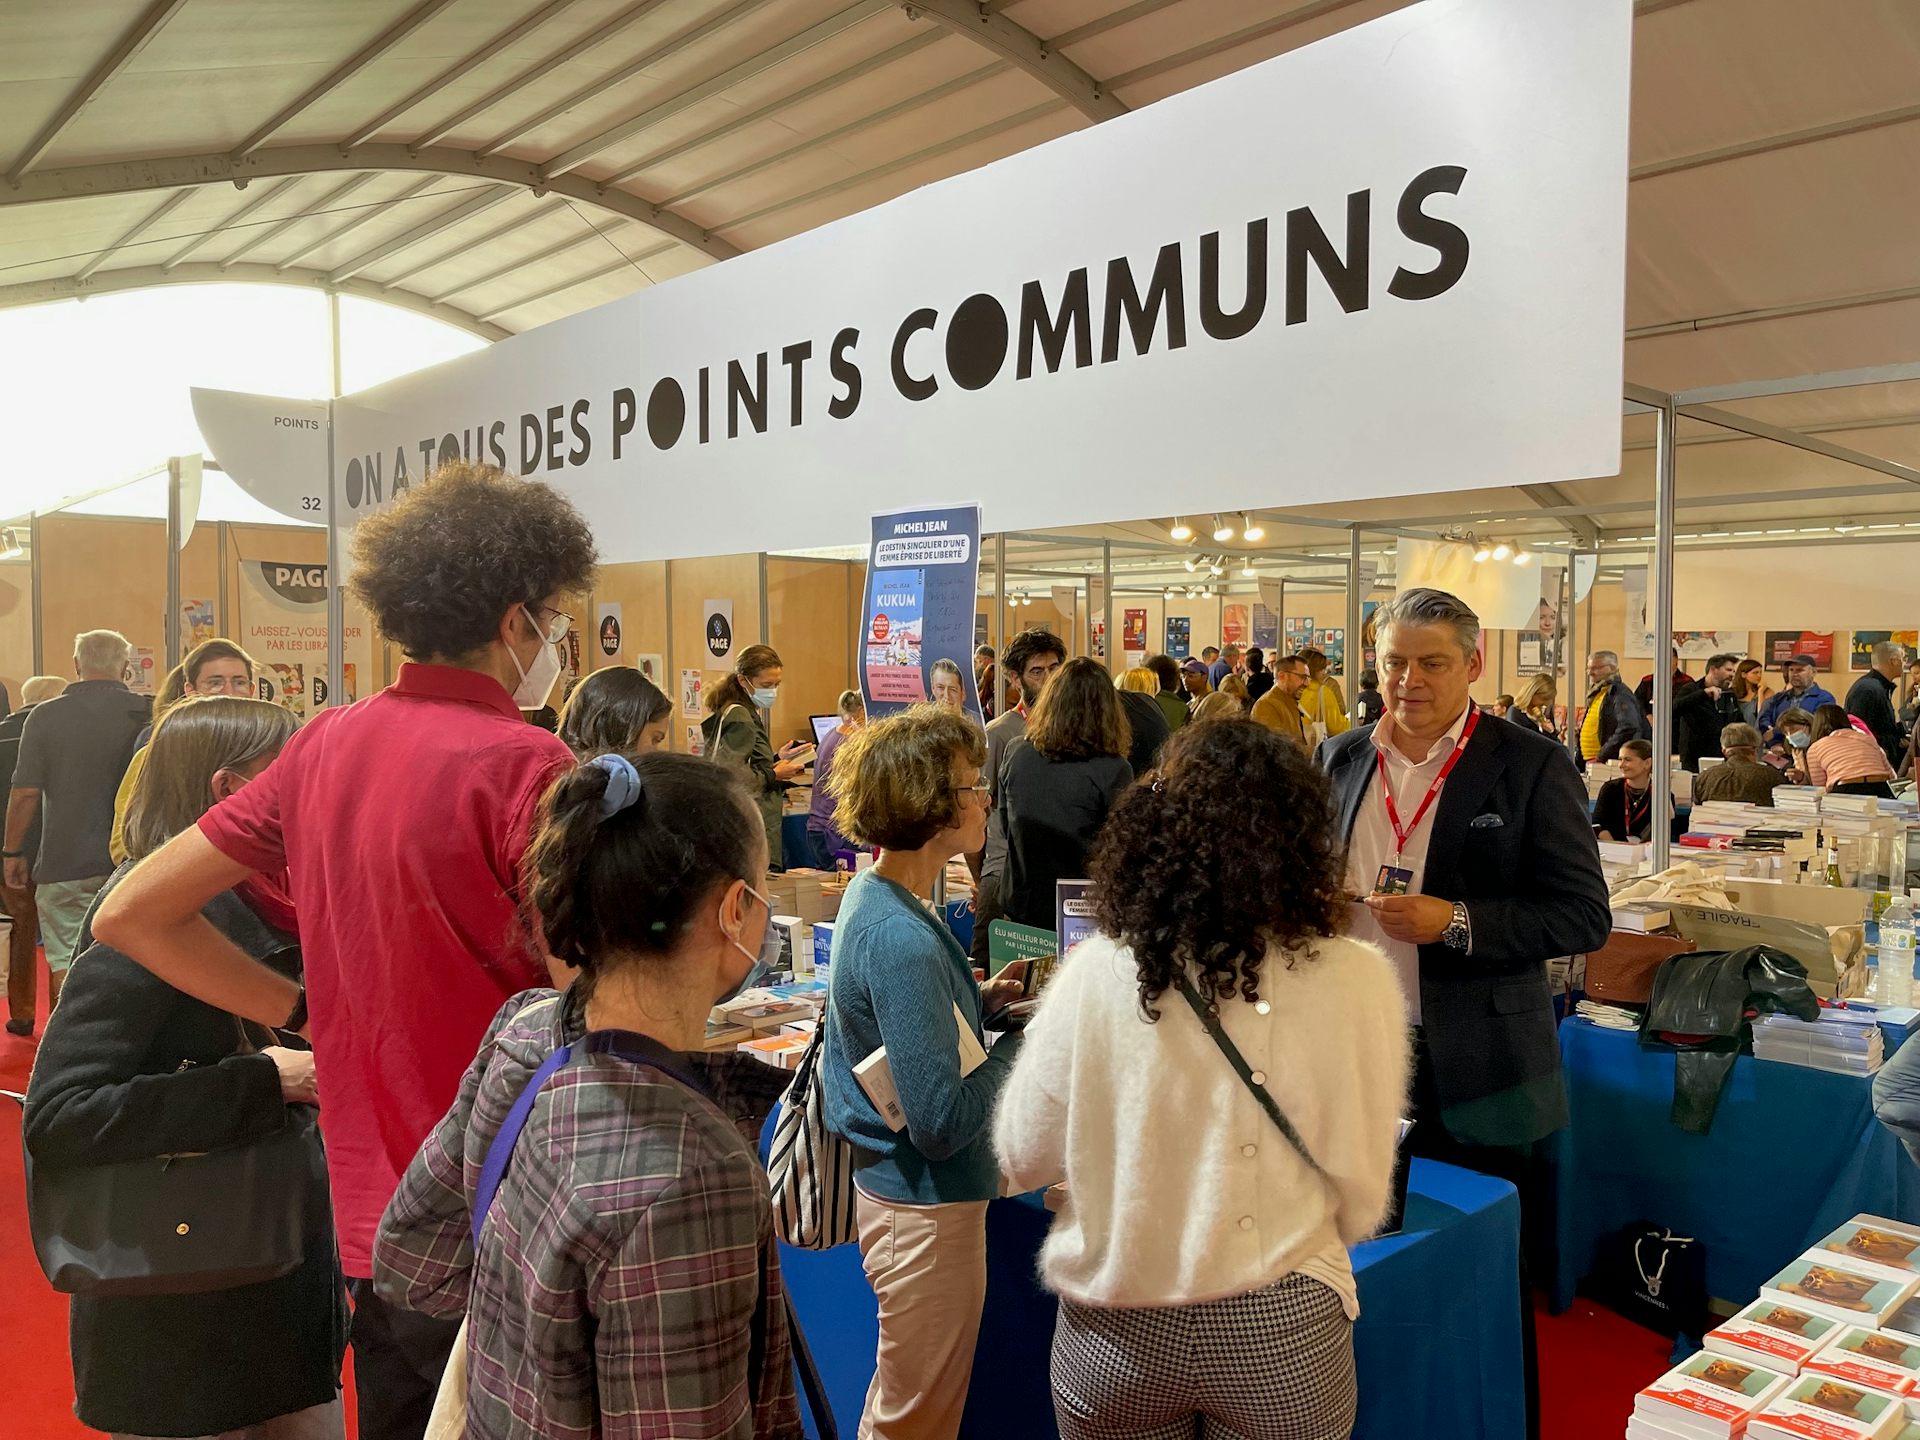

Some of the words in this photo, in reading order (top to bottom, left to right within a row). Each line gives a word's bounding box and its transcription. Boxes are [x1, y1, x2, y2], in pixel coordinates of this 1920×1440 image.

[345, 451, 382, 509] ON
[390, 445, 410, 497] A
[520, 398, 591, 476] DES
[612, 327, 862, 460] POINTS
[890, 165, 1470, 402] COMMUNS
[273, 416, 320, 431] POINTS
[301, 496, 322, 511] 32
[893, 522, 924, 535] MICHEL
[925, 520, 948, 533] JEAN
[879, 544, 886, 552] LE
[886, 542, 906, 552] DESTIN
[906, 540, 942, 550] SINGULIER
[943, 539, 966, 548] D'UNE
[880, 553, 900, 562] FEMME
[901, 550, 923, 561] ÉPRISE
[924, 552, 934, 560] DE
[934, 548, 962, 560] LIBERTÉ
[876, 592, 916, 608] KUKUM
[251, 626, 328, 637] LAISSEZ-VOUS
[266, 640, 285, 650] PAR
[287, 640, 303, 651] LES
[305, 640, 348, 651] LIBRAS
[603, 638, 618, 649] PAGE
[710, 637, 729, 650] PAGE
[1697, 909, 1761, 929] FRAGILE
[994, 927, 1007, 938] ÉLU
[1008, 930, 1038, 945] MEILLEUR
[1039, 937, 1057, 949] ROMA
[1005, 940, 1016, 948] PAR
[1016, 943, 1026, 951] LES
